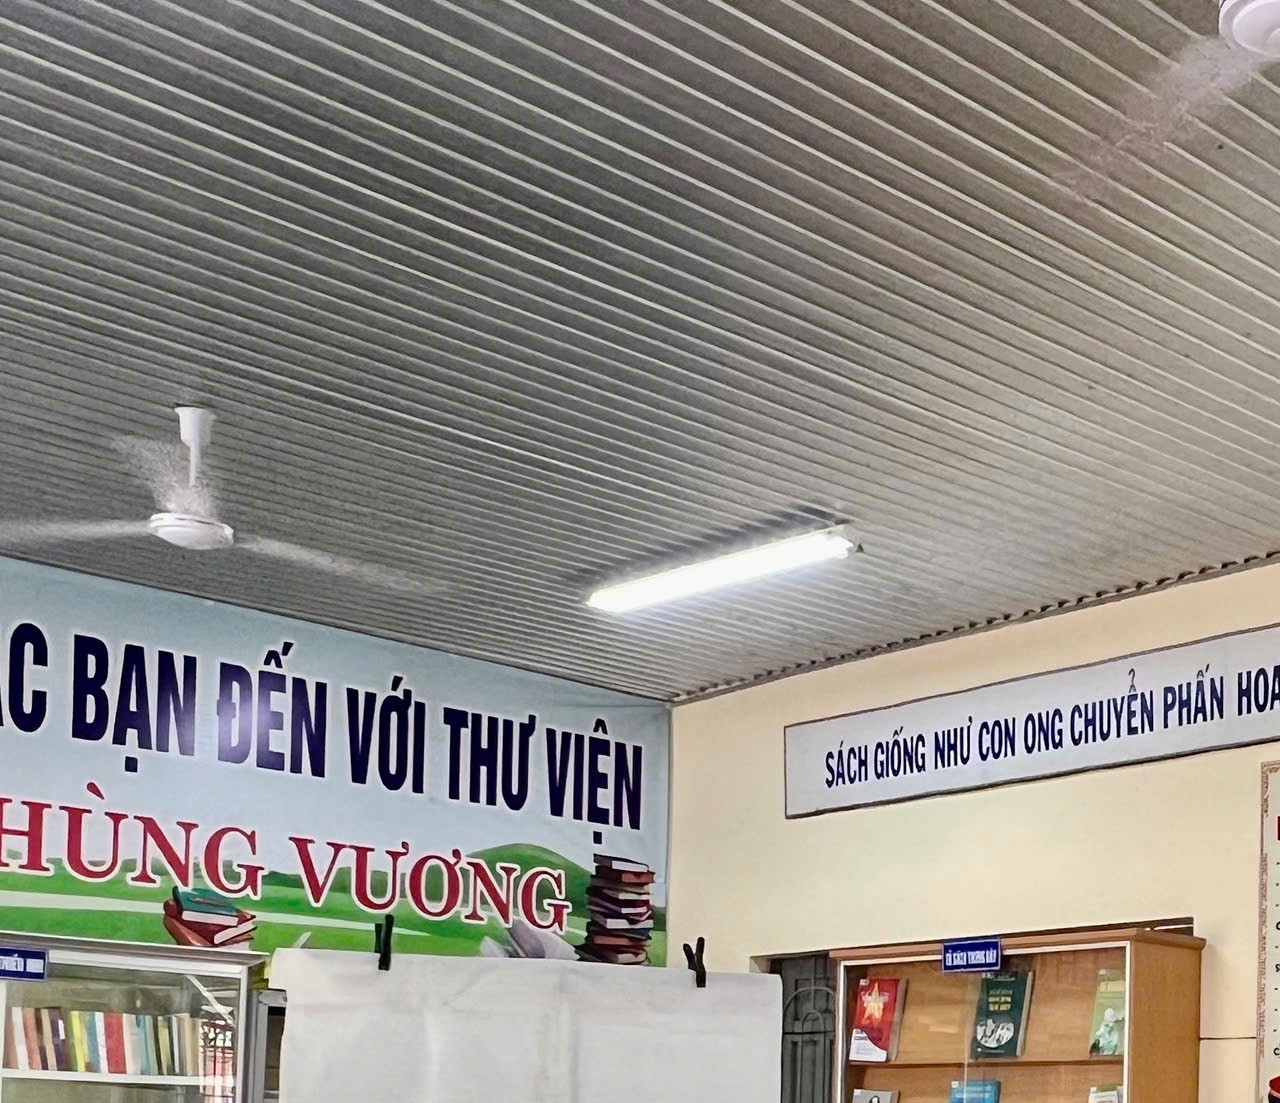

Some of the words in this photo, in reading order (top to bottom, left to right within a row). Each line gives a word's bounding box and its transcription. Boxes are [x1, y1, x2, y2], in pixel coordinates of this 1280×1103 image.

[0, 622, 48, 732] C
[72, 634, 197, 773] BẠN
[217, 641, 327, 777] ĐẾN
[346, 675, 426, 793] VỚI
[443, 707, 536, 811] THƯ
[545, 718, 642, 844] VIỆN
[826, 740, 868, 788] SÁCH
[874, 726, 925, 779] GIỐNG
[935, 716, 972, 769] NHƯ
[979, 718, 1015, 761] CON
[1024, 709, 1063, 754] ONG
[1071, 669, 1153, 746] CHUYỂN
[1164, 664, 1223, 728] PHẤN
[0, 782, 265, 899] HÙNG
[288, 838, 572, 933] VƯƠNG
